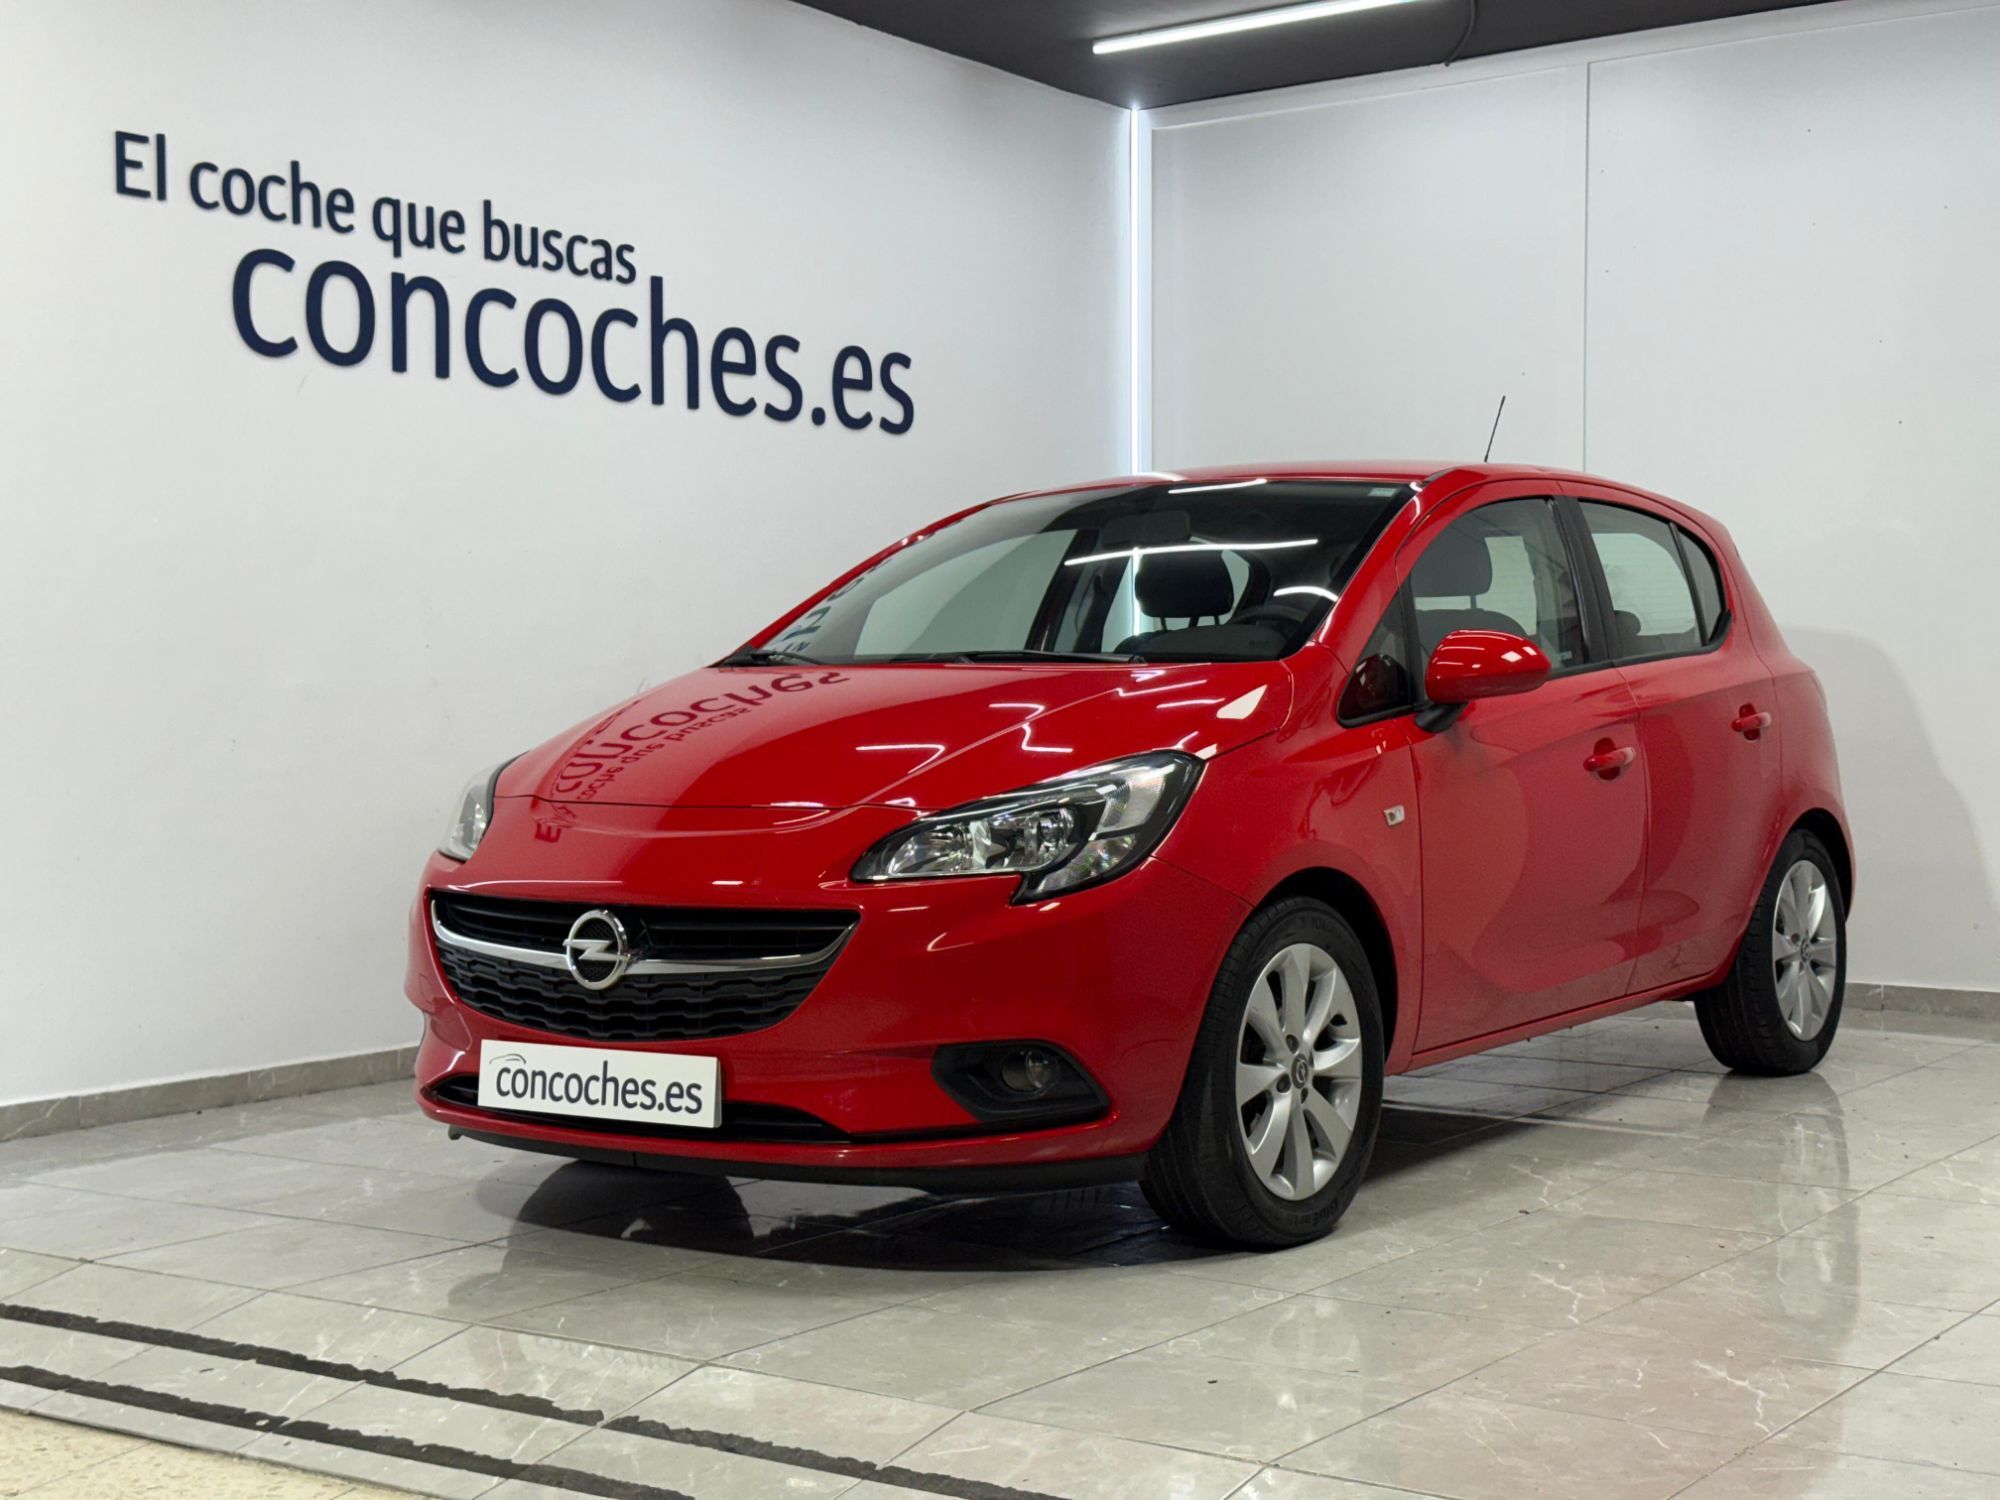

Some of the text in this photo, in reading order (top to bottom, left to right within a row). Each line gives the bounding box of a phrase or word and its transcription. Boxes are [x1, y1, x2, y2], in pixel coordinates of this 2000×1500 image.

[115, 130, 637, 285] El coche que buscas
[232, 248, 915, 436] concoches.es
[496, 1060, 703, 1115] concoches.es
